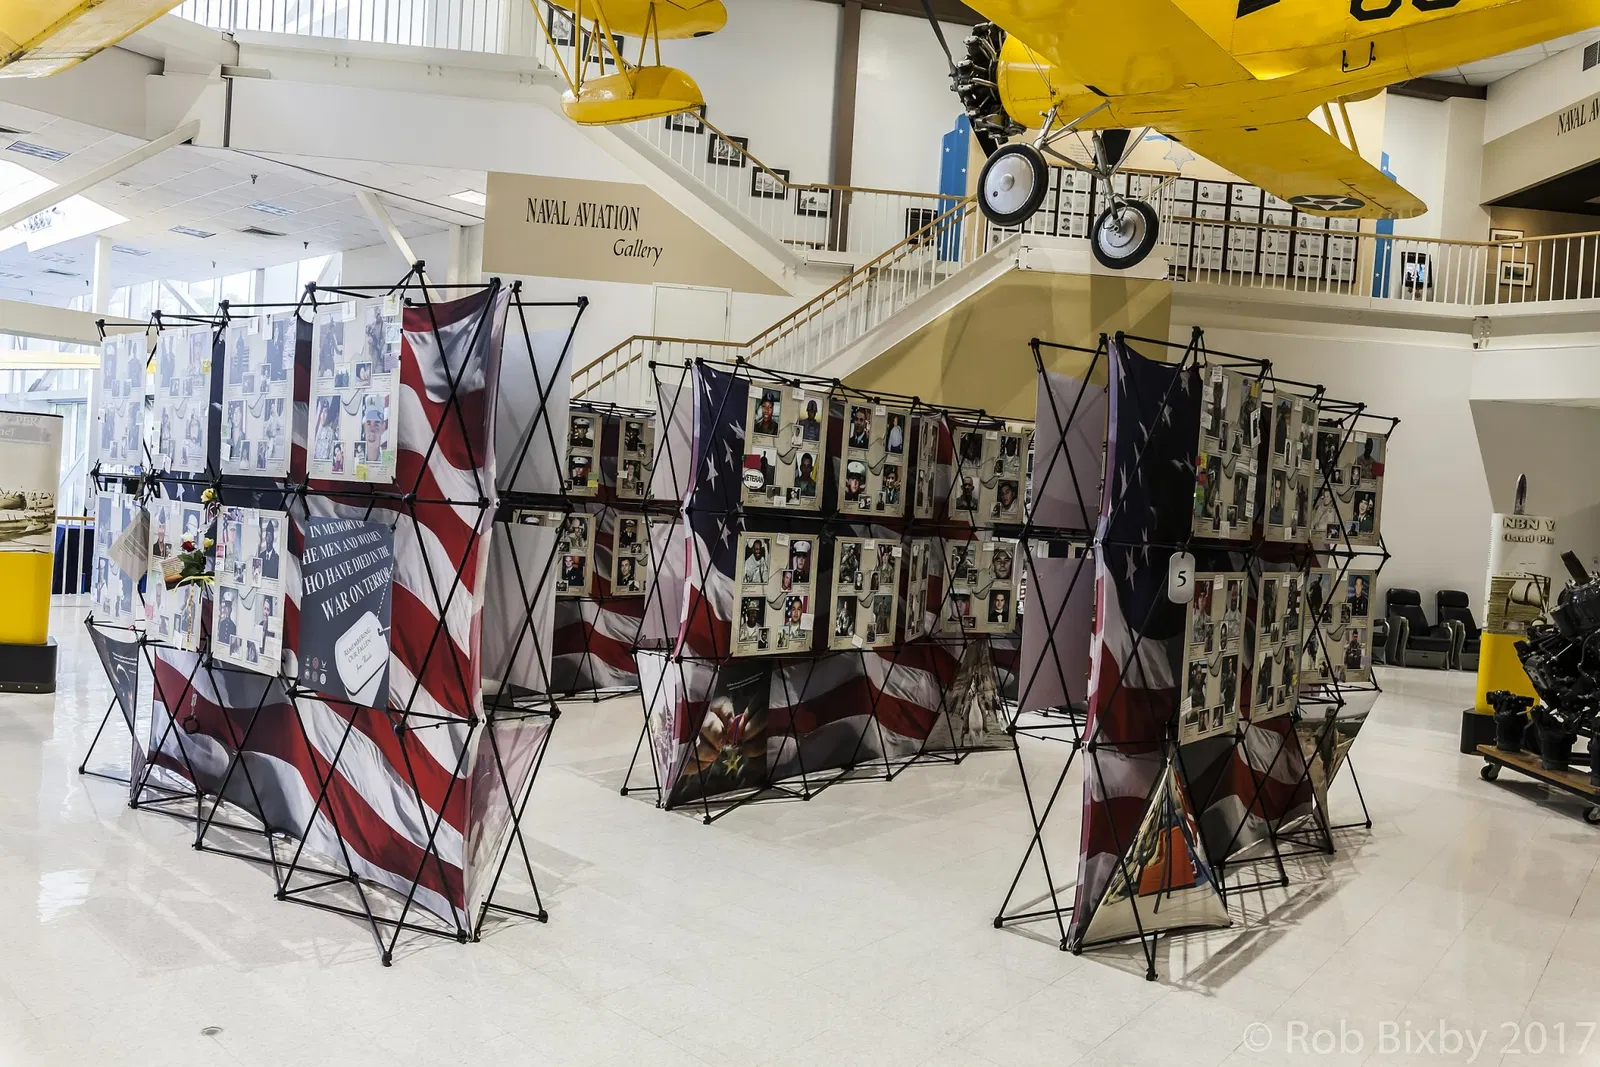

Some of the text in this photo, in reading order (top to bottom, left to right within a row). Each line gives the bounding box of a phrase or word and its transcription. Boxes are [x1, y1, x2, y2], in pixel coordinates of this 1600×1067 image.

[1557, 104, 1586, 136] NAVAL
[525, 198, 640, 231] NAVAL AVIATION
[613, 239, 664, 266] Gallery
[309, 525, 322, 538] IN
[321, 519, 357, 536] MEMORY
[319, 540, 342, 560] MEN
[341, 536, 359, 552] AND
[358, 530, 382, 545] WOMEN
[300, 545, 390, 598] HO HAVE DIED IN THE
[1177, 570, 1187, 588] 5
[321, 566, 390, 621] WAR ON TERROR
